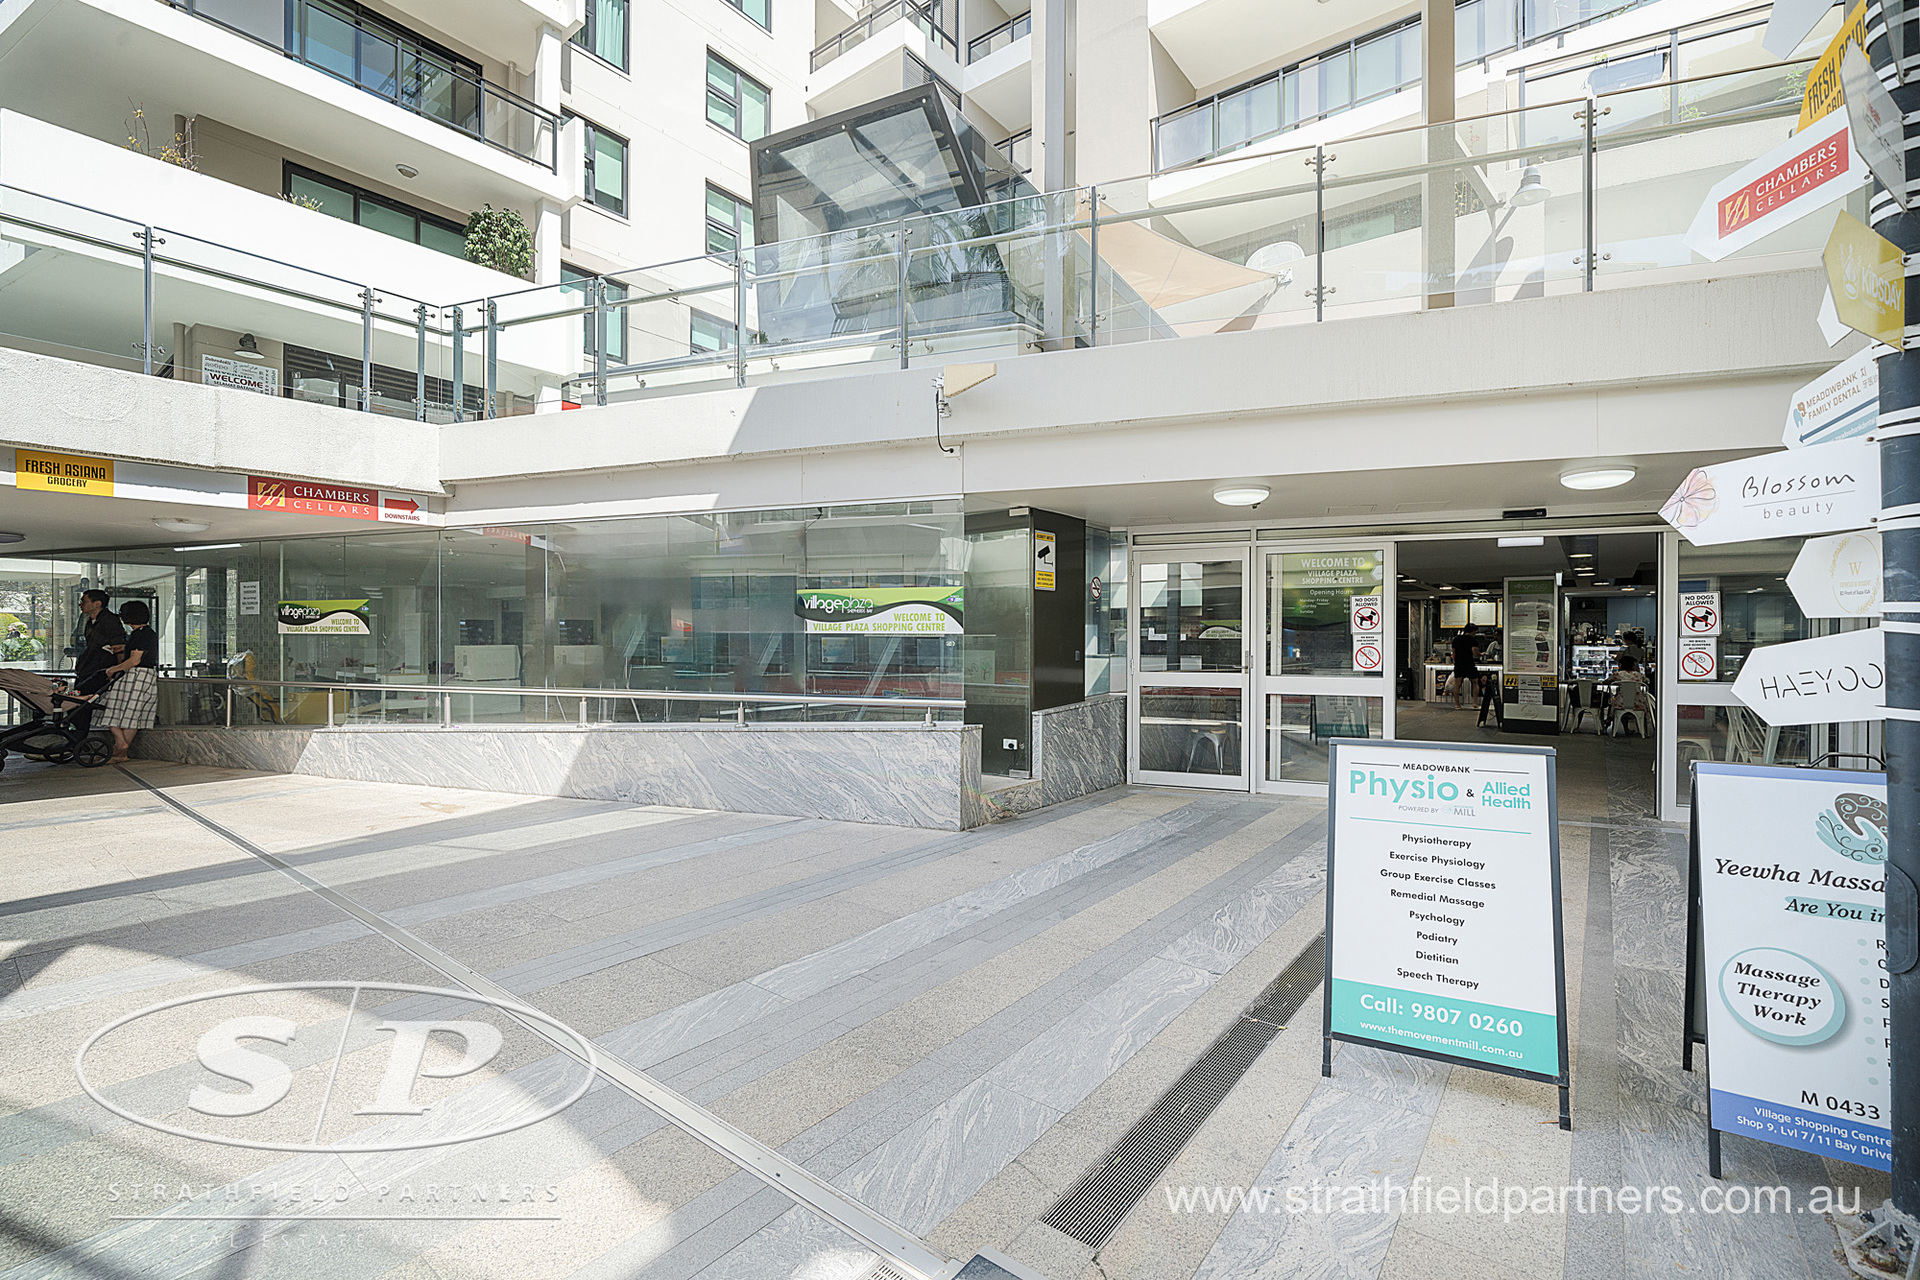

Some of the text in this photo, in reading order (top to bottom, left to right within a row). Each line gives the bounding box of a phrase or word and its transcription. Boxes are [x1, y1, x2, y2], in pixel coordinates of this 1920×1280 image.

[1808, 57, 1836, 119] FRESH
[1756, 141, 1837, 197] CHAMBERS
[1756, 160, 1837, 212] CELLARS
[209, 372, 264, 389] WELCOME
[1806, 371, 1858, 408] MEADOWBANK
[1808, 385, 1861, 420] FAMILY DENTAL
[25, 459, 106, 480] FRESH ASIANA
[47, 476, 88, 488] GROCERY
[1742, 474, 1855, 499] Blossom
[293, 486, 370, 503] CHAMBERS
[293, 500, 370, 515] CELLARS
[384, 512, 421, 522] DOWNSTAIRS
[1763, 502, 1834, 519] beauty
[1300, 557, 1365, 568] WELCOME TO
[1848, 561, 1862, 576] W
[1302, 576, 1363, 585] SHOPPING CENTRE
[813, 623, 946, 632] VILLAGE PLAZA SHOPPING CENTRE
[893, 613, 946, 622] WELCOME TO
[1402, 763, 1471, 773] MEADOWBANK
[1350, 769, 1475, 803] Physio &
[1482, 781, 1530, 797] Allied
[1398, 804, 1429, 813] POWERED
[1453, 807, 1476, 817] MILL
[1481, 795, 1531, 810] Health
[1402, 833, 1472, 849] Physiotherapy
[1389, 851, 1485, 870] Exercise Physiology
[1380, 869, 1496, 890] Group Exercise Classes
[1715, 858, 1886, 893] Yeewha Massa
[1390, 888, 1485, 909] Remedial Massage
[1409, 910, 1465, 927] Psychology
[1785, 898, 1818, 914] Are
[1826, 903, 1862, 920] You
[1416, 931, 1458, 946] Podiatry
[1415, 950, 1459, 965] Dietitian
[1397, 967, 1479, 990] Speech Therapy
[1734, 962, 1821, 988] Massage
[1737, 982, 1822, 1010] Therapy
[1360, 994, 1523, 1037] Call: 9807 0260
[1753, 1004, 1807, 1026] Work
[1360, 1021, 1523, 1059] www.themovementmill.com.au
[1801, 1090, 1881, 1120] M 0433
[1754, 1107, 1891, 1147] Village Shopping Centre
[1737, 1115, 1763, 1130] Shop
[1780, 1126, 1798, 1138] Lvl
[1835, 1139, 1857, 1154] Bay
[1861, 1145, 1891, 1161] Drive
